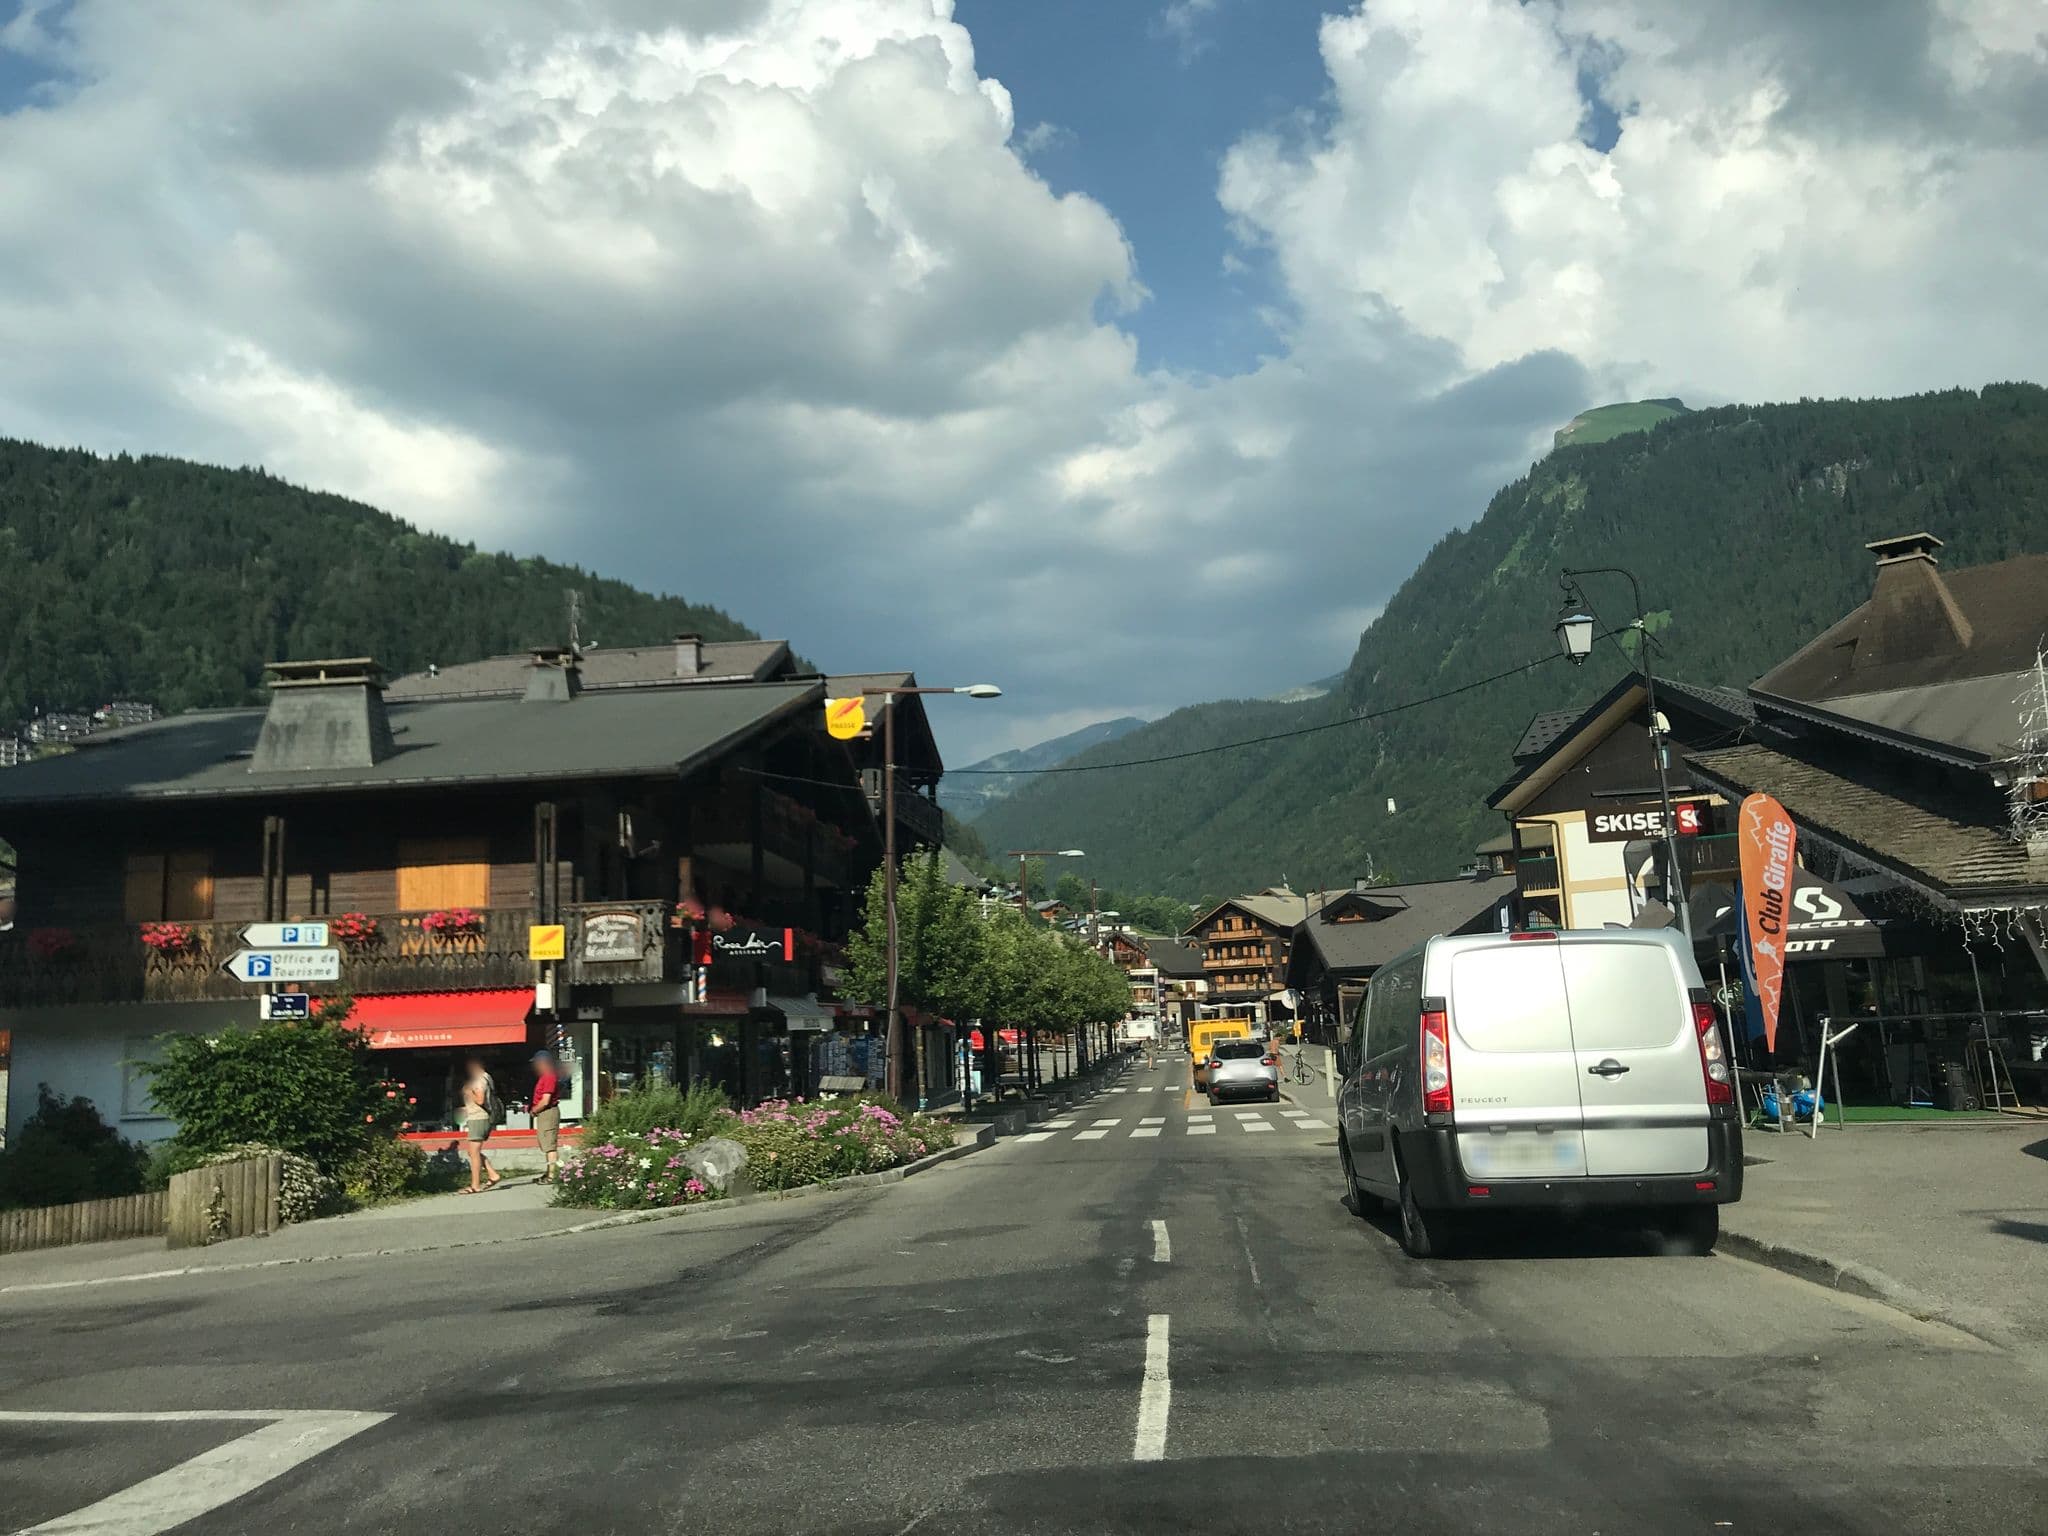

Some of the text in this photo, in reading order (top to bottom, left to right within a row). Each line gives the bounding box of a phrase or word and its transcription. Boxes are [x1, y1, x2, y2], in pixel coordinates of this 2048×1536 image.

[1595, 811, 1676, 832] SKISE
[1784, 939, 1835, 952] OTT
[274, 953, 336, 964] Office de
[274, 967, 332, 977] Tourisme
